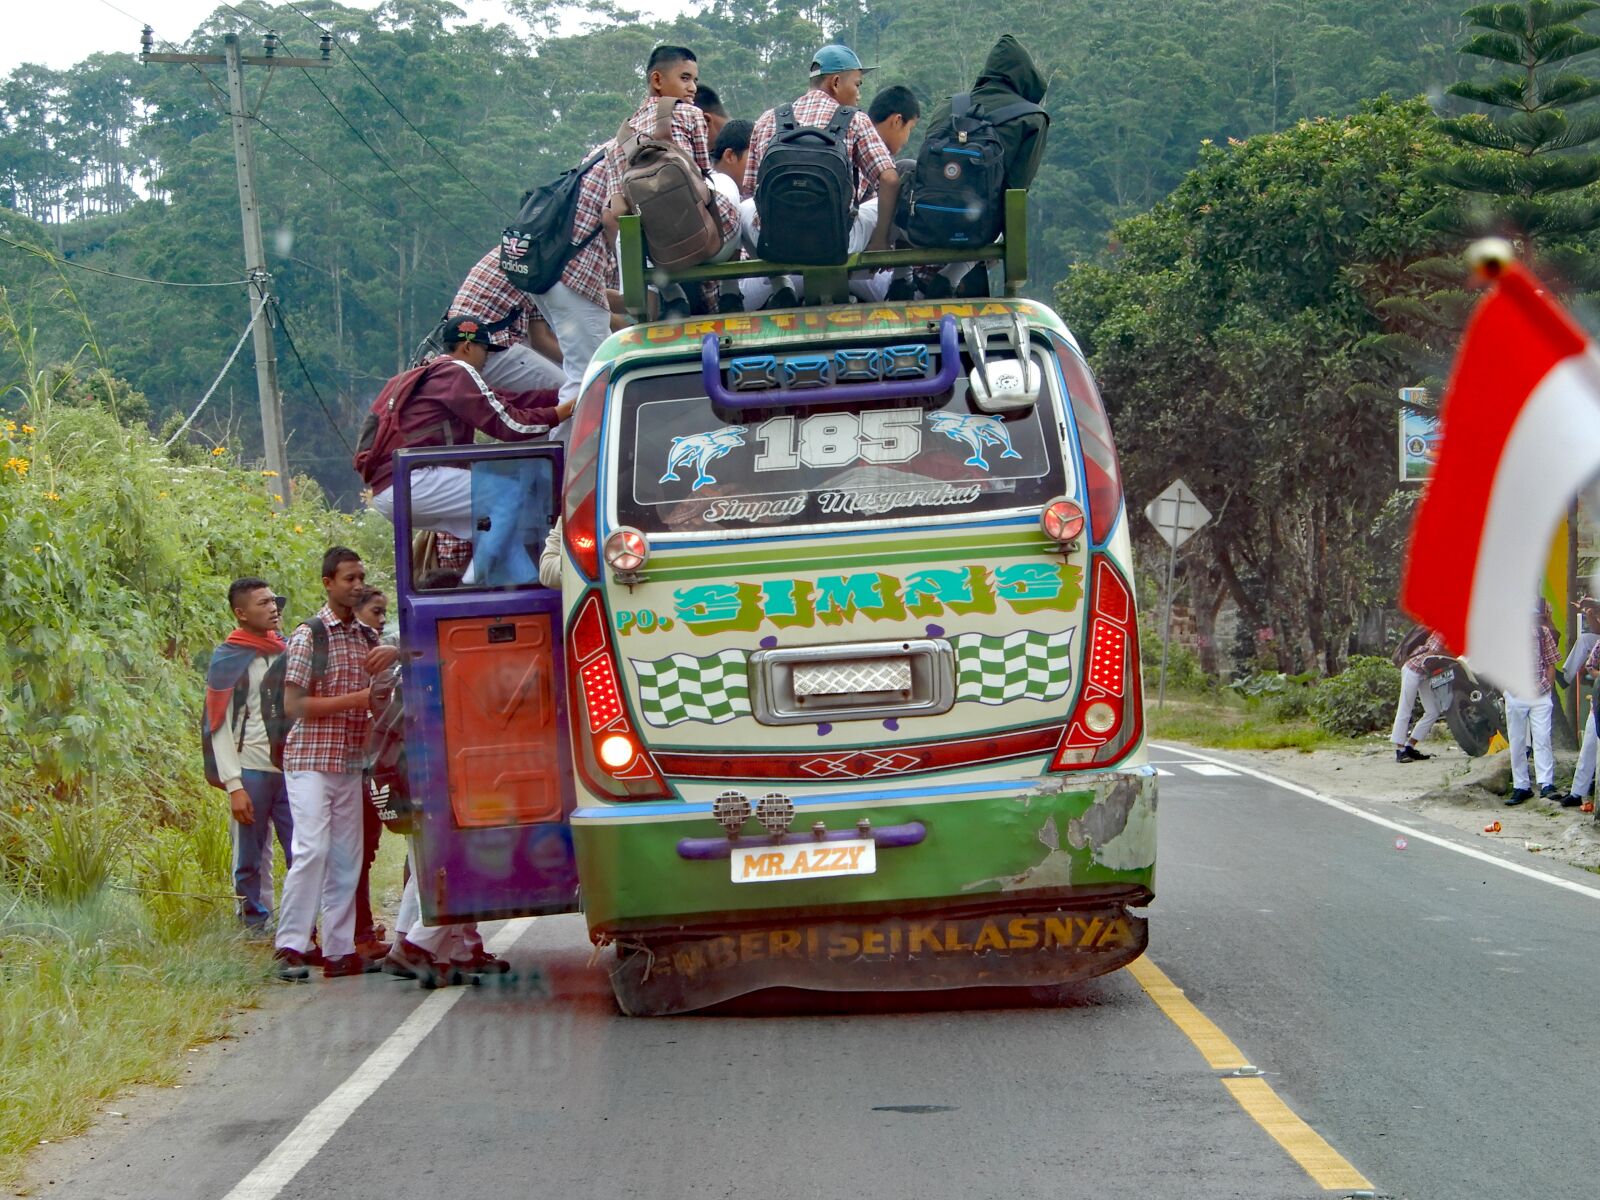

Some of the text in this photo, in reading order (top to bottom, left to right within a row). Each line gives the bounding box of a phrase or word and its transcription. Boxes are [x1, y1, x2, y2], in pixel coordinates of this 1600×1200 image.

[501, 260, 529, 274] adidas
[754, 407, 923, 472] 185
[703, 484, 981, 522] Simpati Masyarakat
[616, 609, 674, 636] PO.
[743, 846, 866, 878] MR.AZZY
